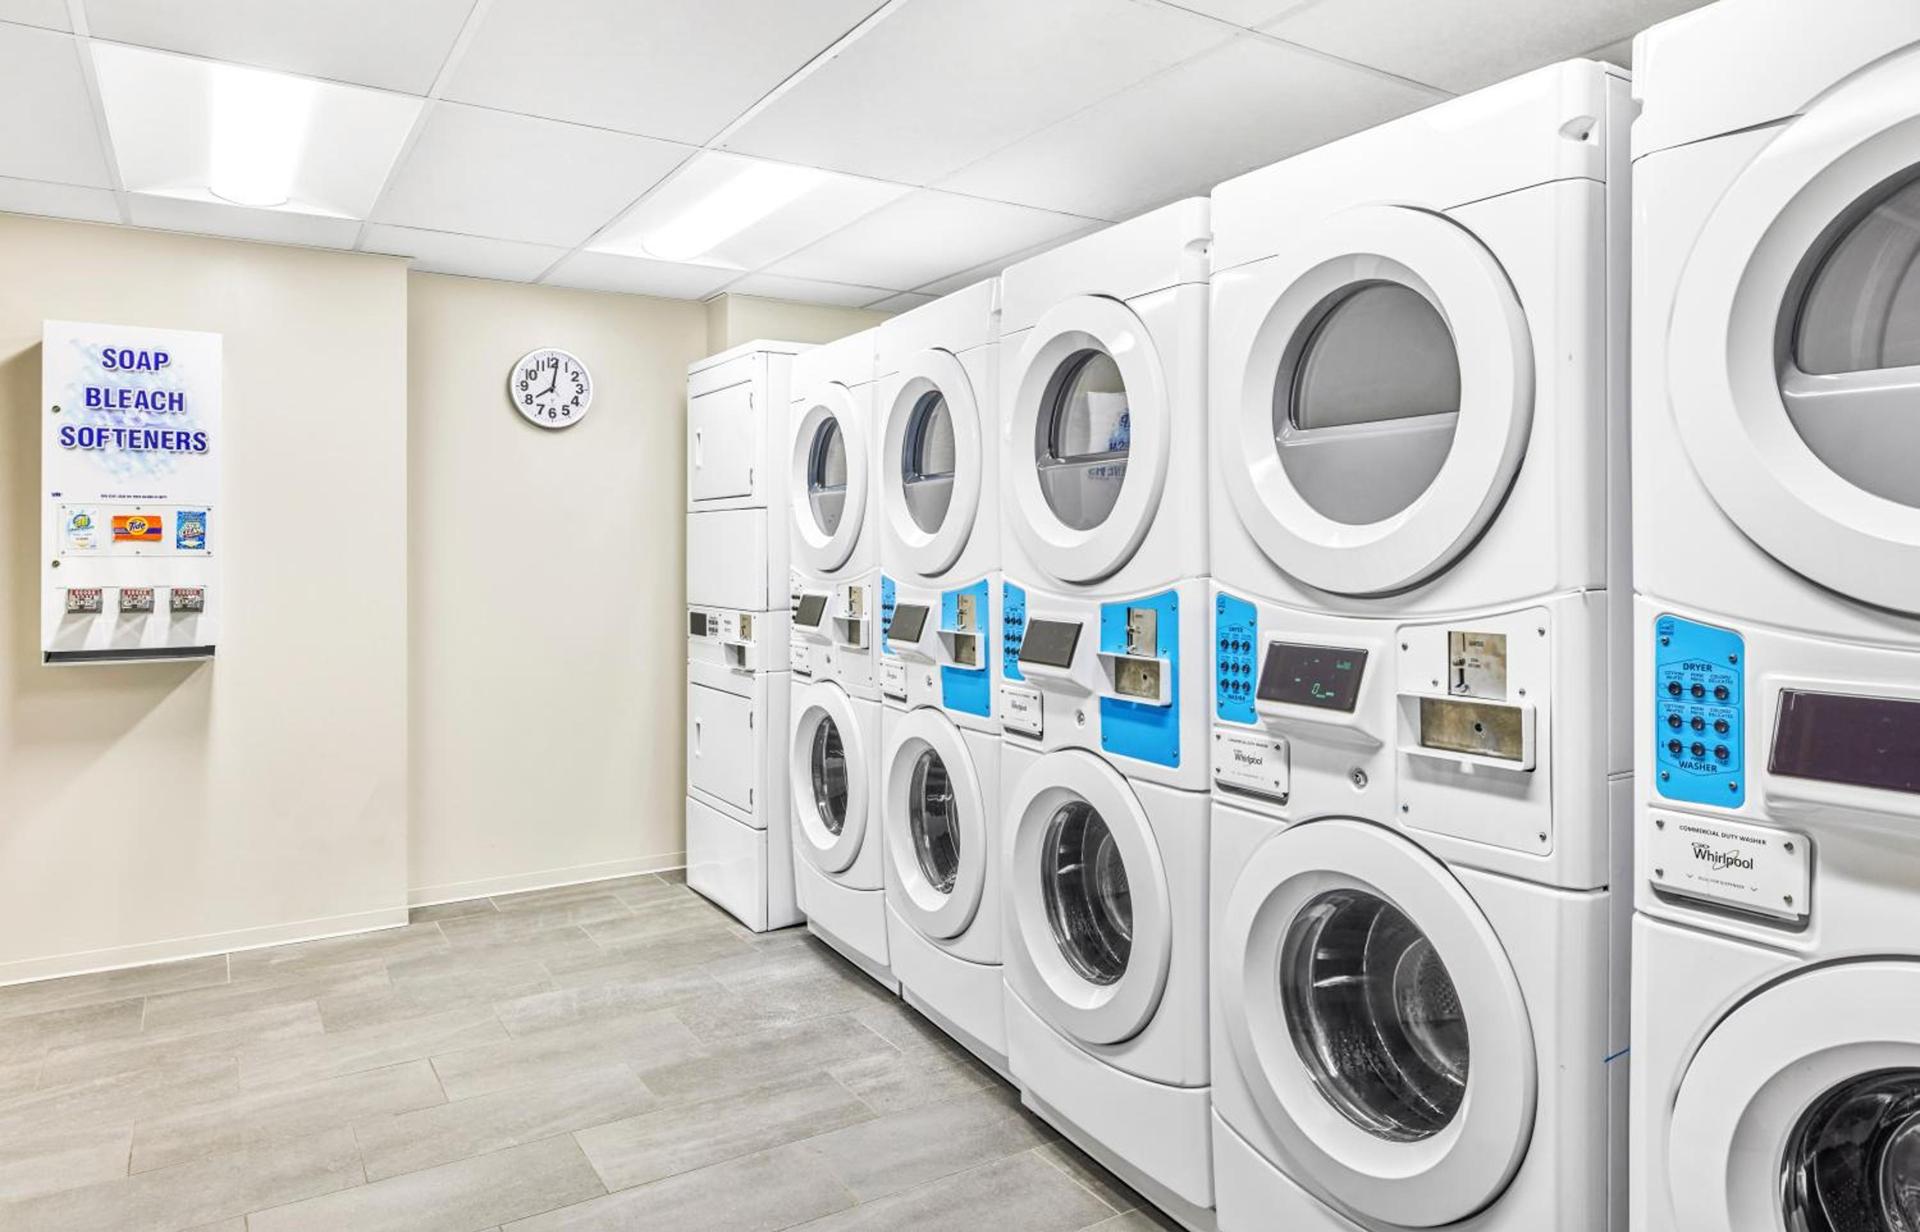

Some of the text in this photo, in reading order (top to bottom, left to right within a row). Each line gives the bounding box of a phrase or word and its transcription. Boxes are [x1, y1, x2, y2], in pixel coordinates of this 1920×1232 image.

[102, 349, 170, 371] SOAP
[536, 360, 545, 371] 11
[547, 357, 559, 368] 12
[525, 369, 537, 381] 10
[571, 371, 580, 382] 2
[520, 380, 529, 391] 9
[575, 384, 584, 395] 3
[85, 387, 185, 412] BLEACH
[525, 394, 533, 405] 8
[570, 395, 580, 406] 4
[536, 404, 545, 415] 7
[548, 408, 557, 419] 6
[561, 405, 570, 416] 5
[60, 426, 208, 452] SOFTENERS
[128, 521, 146, 532] Tide
[1682, 662, 1713, 672] DRYER
[1678, 760, 1718, 772] WASHER
[1679, 825, 1767, 845] COMMERCIAL DUTY WASHER
[1693, 847, 1754, 870] Whirlpool
